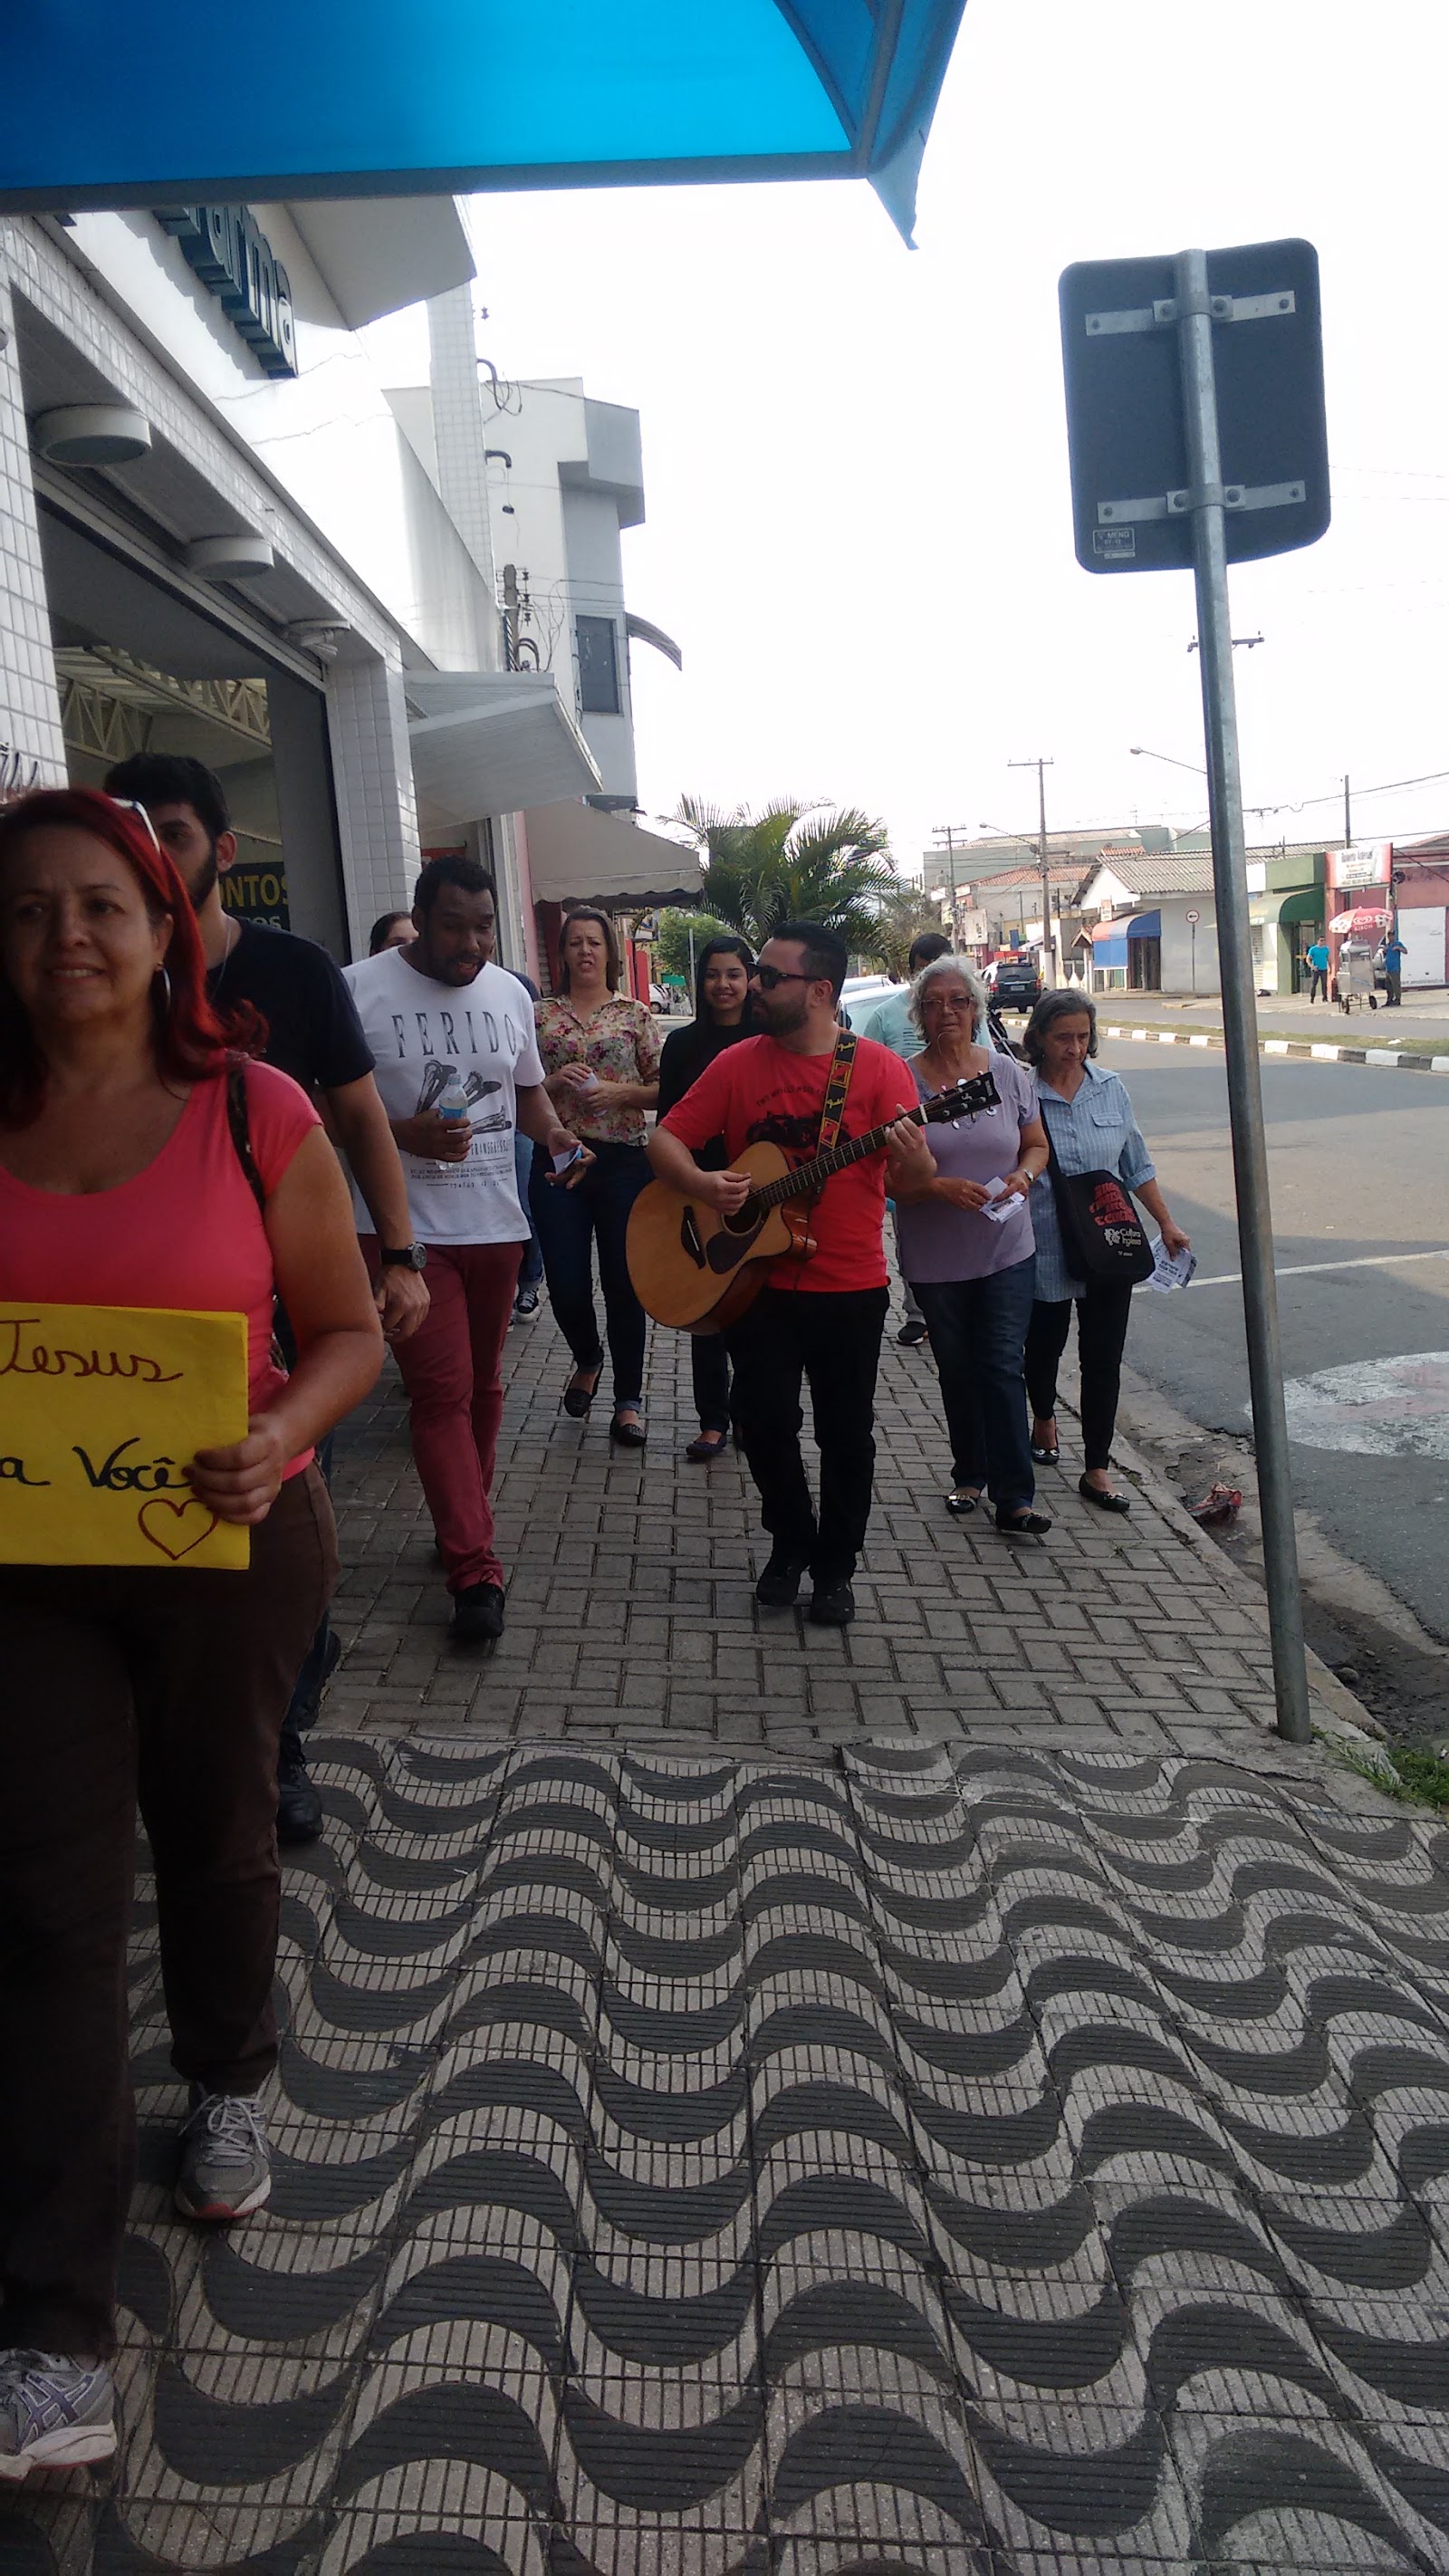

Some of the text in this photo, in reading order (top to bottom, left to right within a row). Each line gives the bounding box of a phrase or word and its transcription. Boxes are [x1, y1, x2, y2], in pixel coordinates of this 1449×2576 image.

[168, 205, 299, 379] arma
[219, 873, 289, 908] NTO
[391, 1011, 517, 1058] FERIDO
[0, 1319, 183, 1382] Jesus
[72, 1437, 193, 1493] Você
